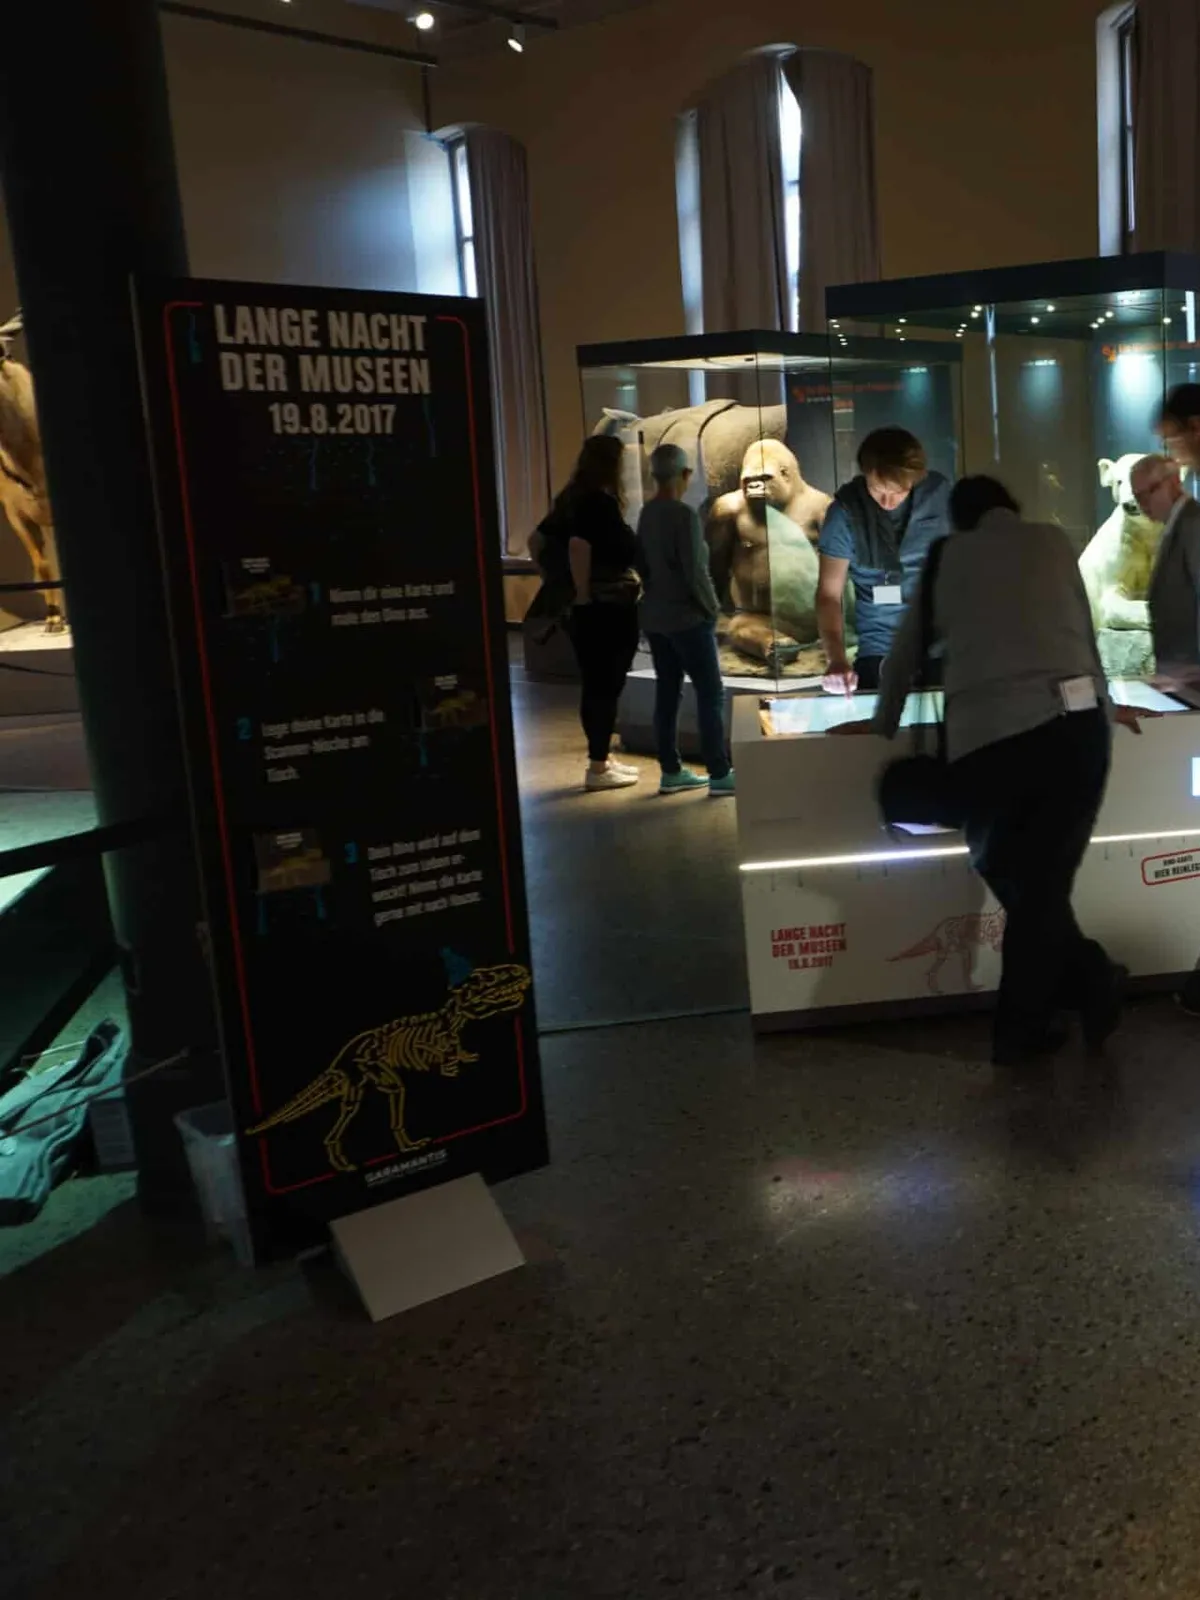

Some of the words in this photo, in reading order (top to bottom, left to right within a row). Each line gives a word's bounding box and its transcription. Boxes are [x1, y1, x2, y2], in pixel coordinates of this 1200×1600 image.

[214, 304, 320, 348] LANGE
[328, 311, 427, 351] NACHT
[220, 352, 288, 392] DER
[299, 354, 431, 395] MUSEEN
[269, 402, 397, 435] 19.8.2017
[405, 582, 433, 598] Karte
[433, 580, 455, 596] und
[235, 716, 252, 740] 2
[323, 712, 353, 728] Karte
[1154, 867, 1171, 880] HIER
[771, 927, 807, 943] LANGE
[809, 923, 847, 939] NACHT
[772, 943, 796, 958] DER
[798, 938, 847, 956] MUSEEN
